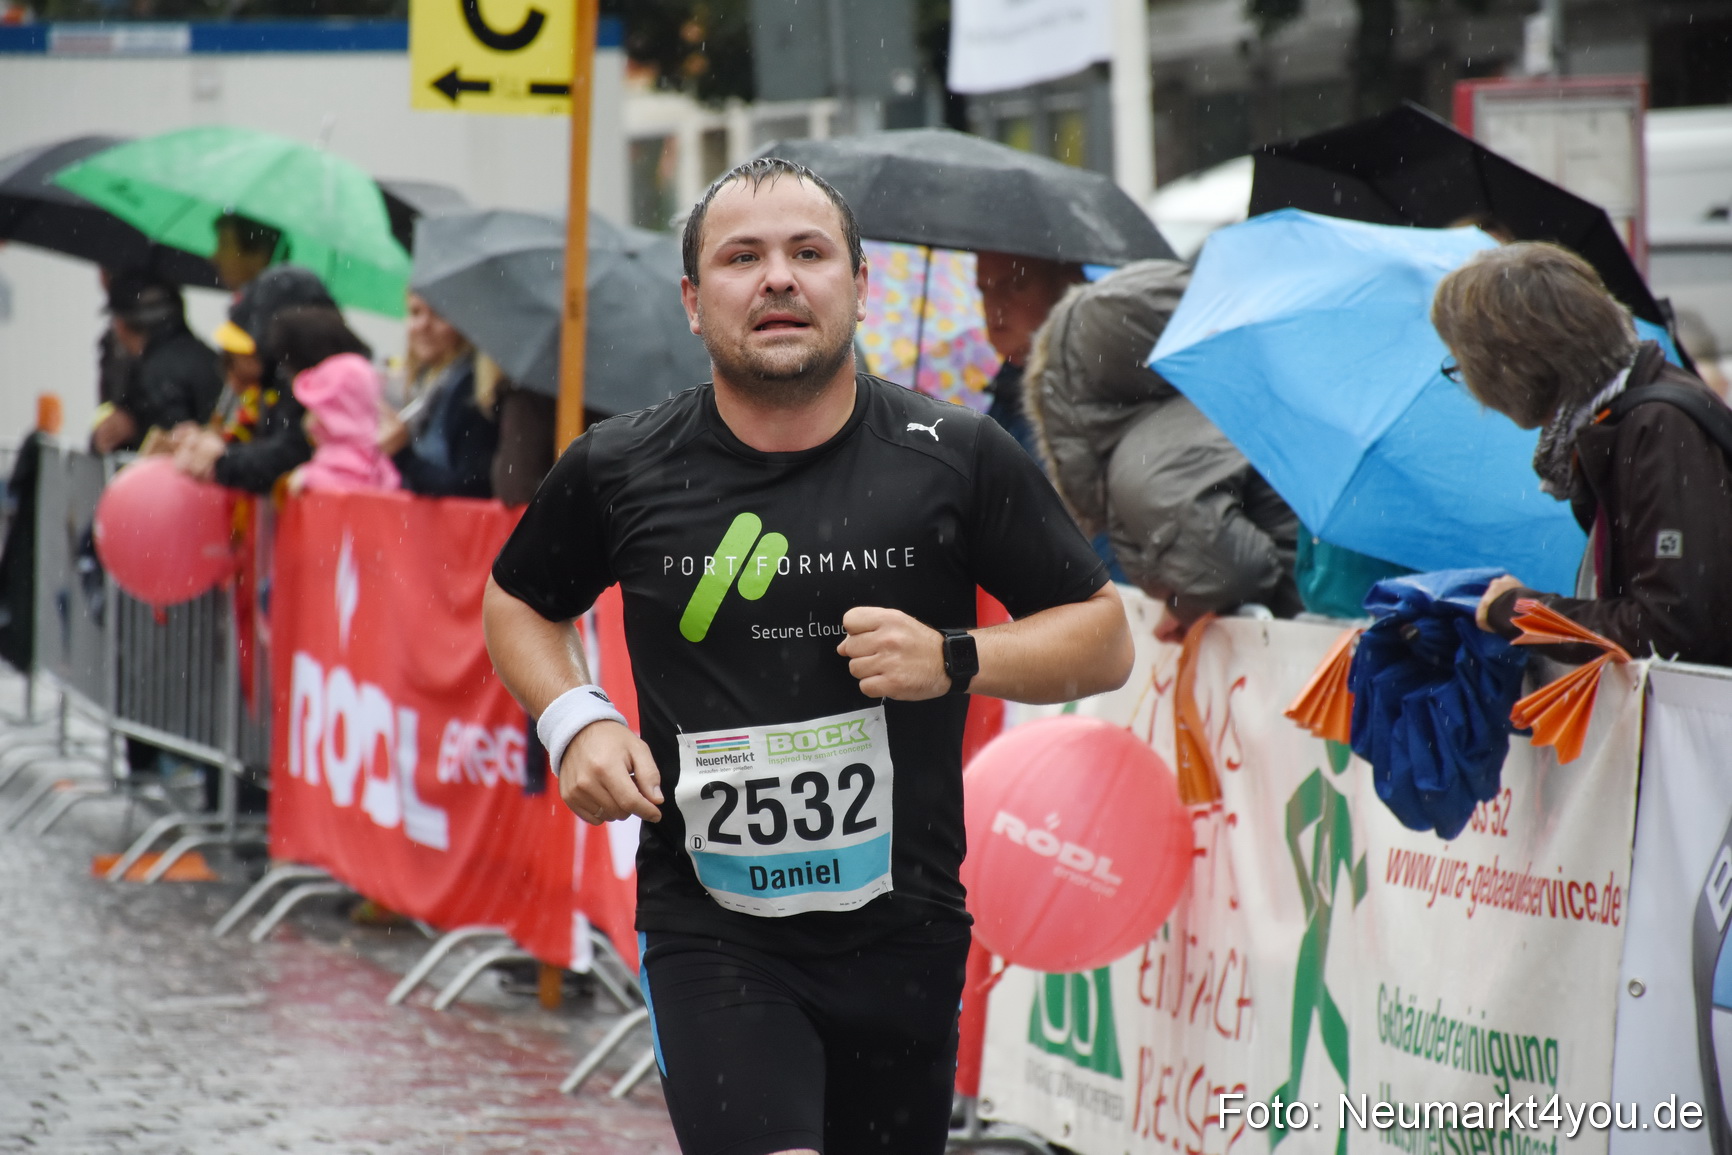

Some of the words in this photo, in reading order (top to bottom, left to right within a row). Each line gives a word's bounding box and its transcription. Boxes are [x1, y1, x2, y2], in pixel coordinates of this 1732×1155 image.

[751, 625, 803, 639] Secure
[766, 718, 871, 757] BOCK
[695, 752, 755, 767] NeuerMarkt
[768, 755, 800, 765] inspired
[802, 753, 812, 763] by
[814, 749, 837, 760] smart
[838, 742, 873, 756] concepts
[700, 762, 877, 846] 2532
[694, 837, 702, 849] D
[749, 858, 841, 891] Daniel
